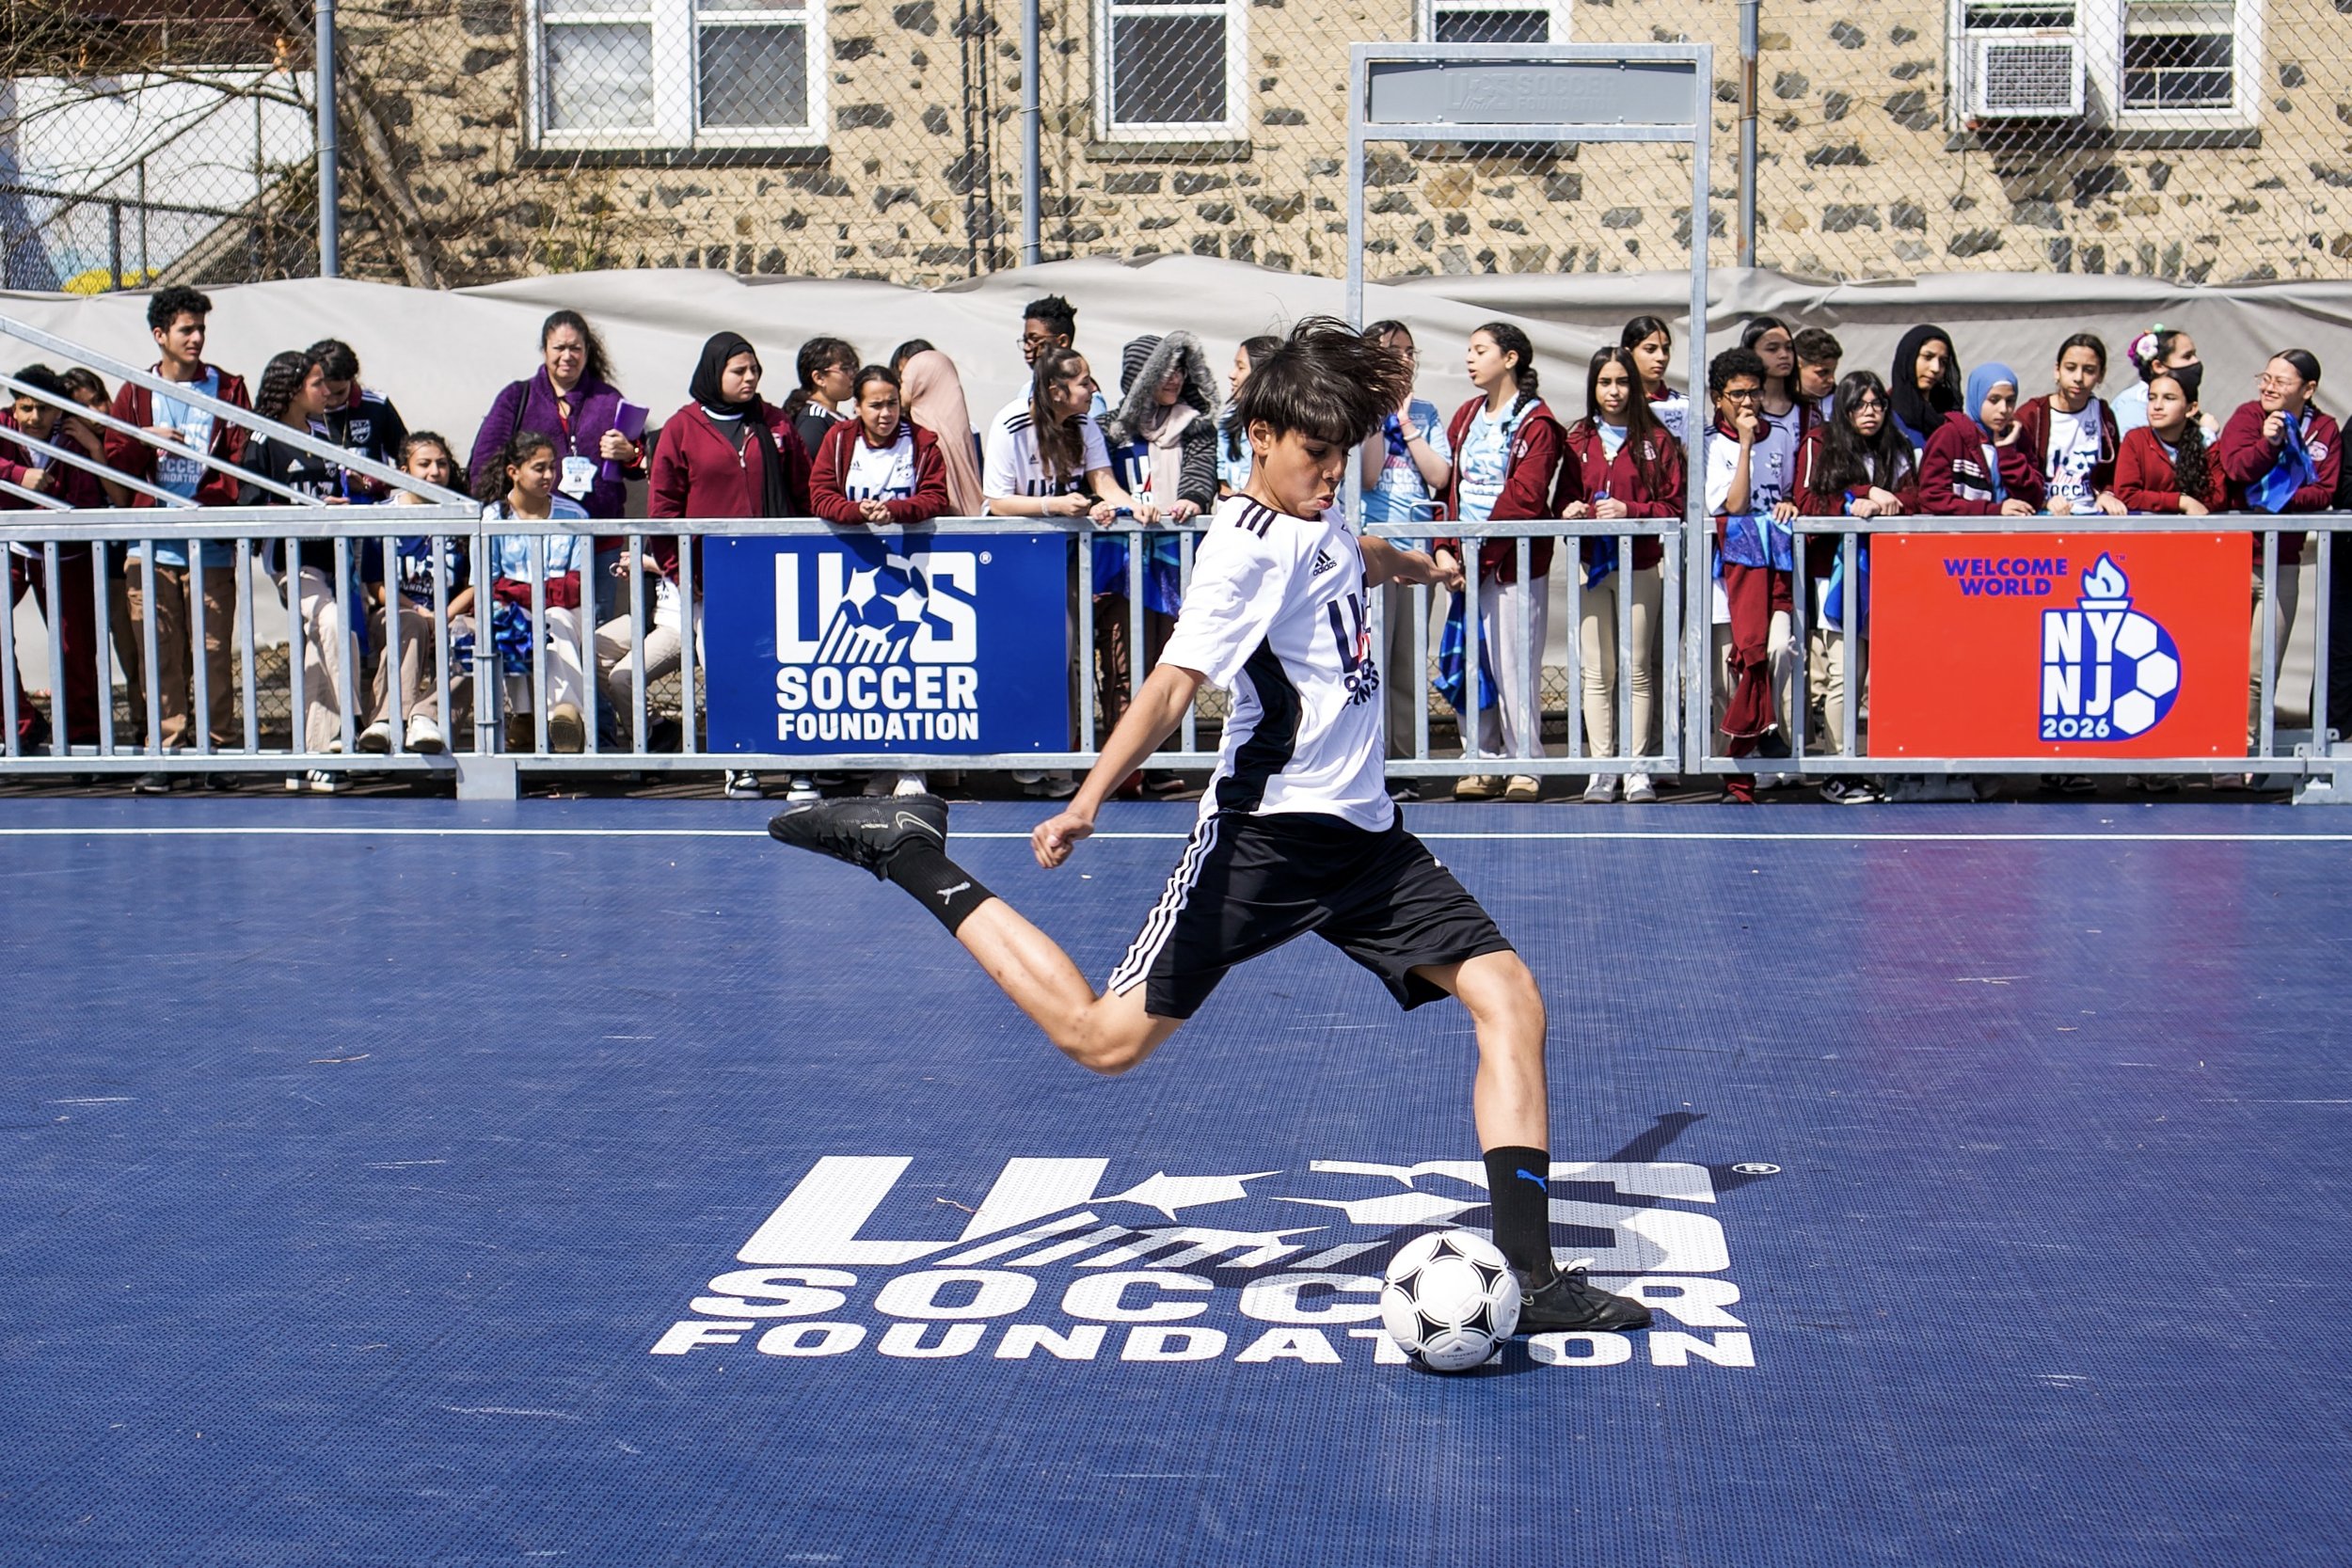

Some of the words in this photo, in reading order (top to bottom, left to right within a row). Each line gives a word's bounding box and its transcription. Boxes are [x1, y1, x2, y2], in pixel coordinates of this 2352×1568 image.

[1517, 72, 1617, 95] SOCCER
[1312, 560, 1338, 577] adidas
[1943, 558, 2068, 577] WELCOME
[1959, 578, 2052, 596] WORLD
[775, 551, 977, 664] US
[2044, 611, 2124, 663] NY
[776, 665, 979, 711] SOCCER
[2042, 664, 2113, 717] NJ
[777, 712, 979, 741] FOUNDATION
[2042, 718, 2111, 738] 2026
[690, 1267, 1747, 1327] SOCCR
[650, 1321, 1756, 1369] FOUNDATON
